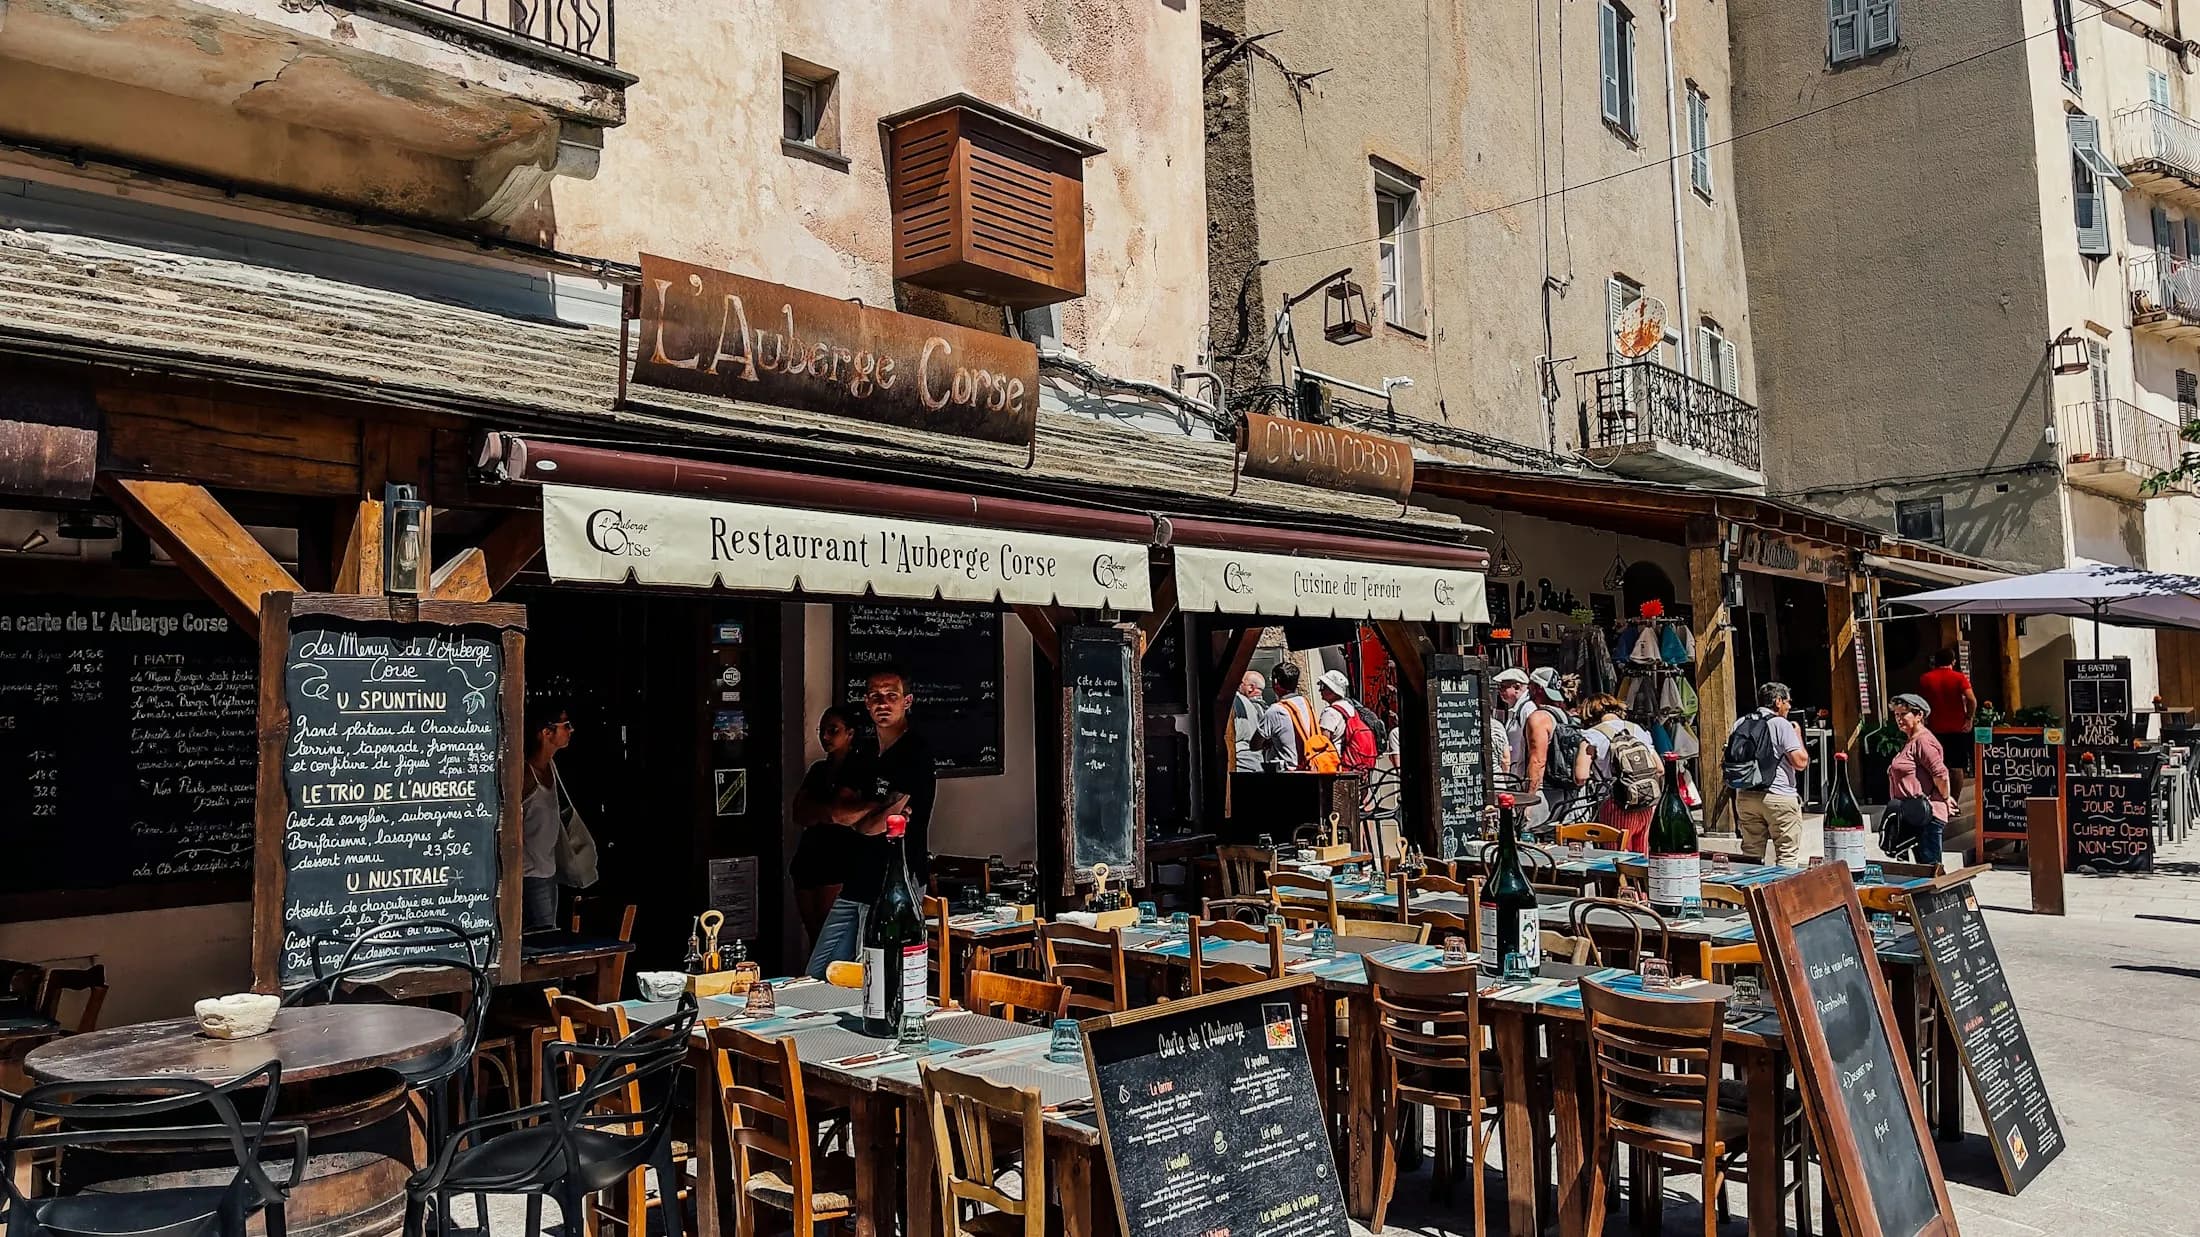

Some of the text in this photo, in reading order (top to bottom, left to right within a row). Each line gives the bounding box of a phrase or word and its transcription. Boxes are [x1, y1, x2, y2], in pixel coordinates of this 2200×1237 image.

[650, 274, 1025, 416] L'Auberge Corse
[1266, 421, 1401, 479] CUCINA CORSA
[710, 516, 1057, 581] Restaurant l'Auberge Corse
[1293, 571, 1401, 601] Cuisine du Terroir
[0, 617, 12, 632] a
[17, 612, 61, 632] carte
[66, 611, 87, 632] de
[110, 610, 178, 636] Auberge
[183, 612, 228, 632] Corse
[300, 629, 492, 667] Les Menus de l'Auberge
[370, 656, 418, 682] Corse
[2078, 664, 2117, 672] LE BASTION
[337, 692, 349, 709] U
[294, 715, 492, 742] Grand plateau de Charcuterie
[2081, 714, 2117, 726] PLATS
[2085, 725, 2114, 736] FAITS
[288, 737, 485, 759] terrine, tapenade, fromages
[1983, 742, 2050, 758] Restaurant
[2078, 734, 2119, 746] MAISON
[290, 755, 430, 777] et confiture de figues
[1984, 759, 2055, 777] Le Bastion
[303, 779, 476, 804] LE TRIO DE L'AUBERGE
[1992, 780, 2032, 794] Cuisine
[2074, 784, 2125, 798] PLAT DU
[286, 803, 492, 831] Civet de sanglier, aubergines à la
[2082, 801, 2114, 814] JOUR
[375, 828, 431, 849] lasagnes
[440, 828, 455, 841] et
[2073, 823, 2148, 841] Cuisine Open
[291, 843, 472, 871] dessert menu 23,50€
[2078, 841, 2147, 856] NON-STOP
[347, 866, 449, 891] U NUSTRALE
[286, 888, 489, 921] Assiette de charcuterie ou aubergine
[340, 915, 354, 929] à
[359, 913, 375, 926] la
[1158, 1019, 1246, 1059] Carte de l'Auberge
